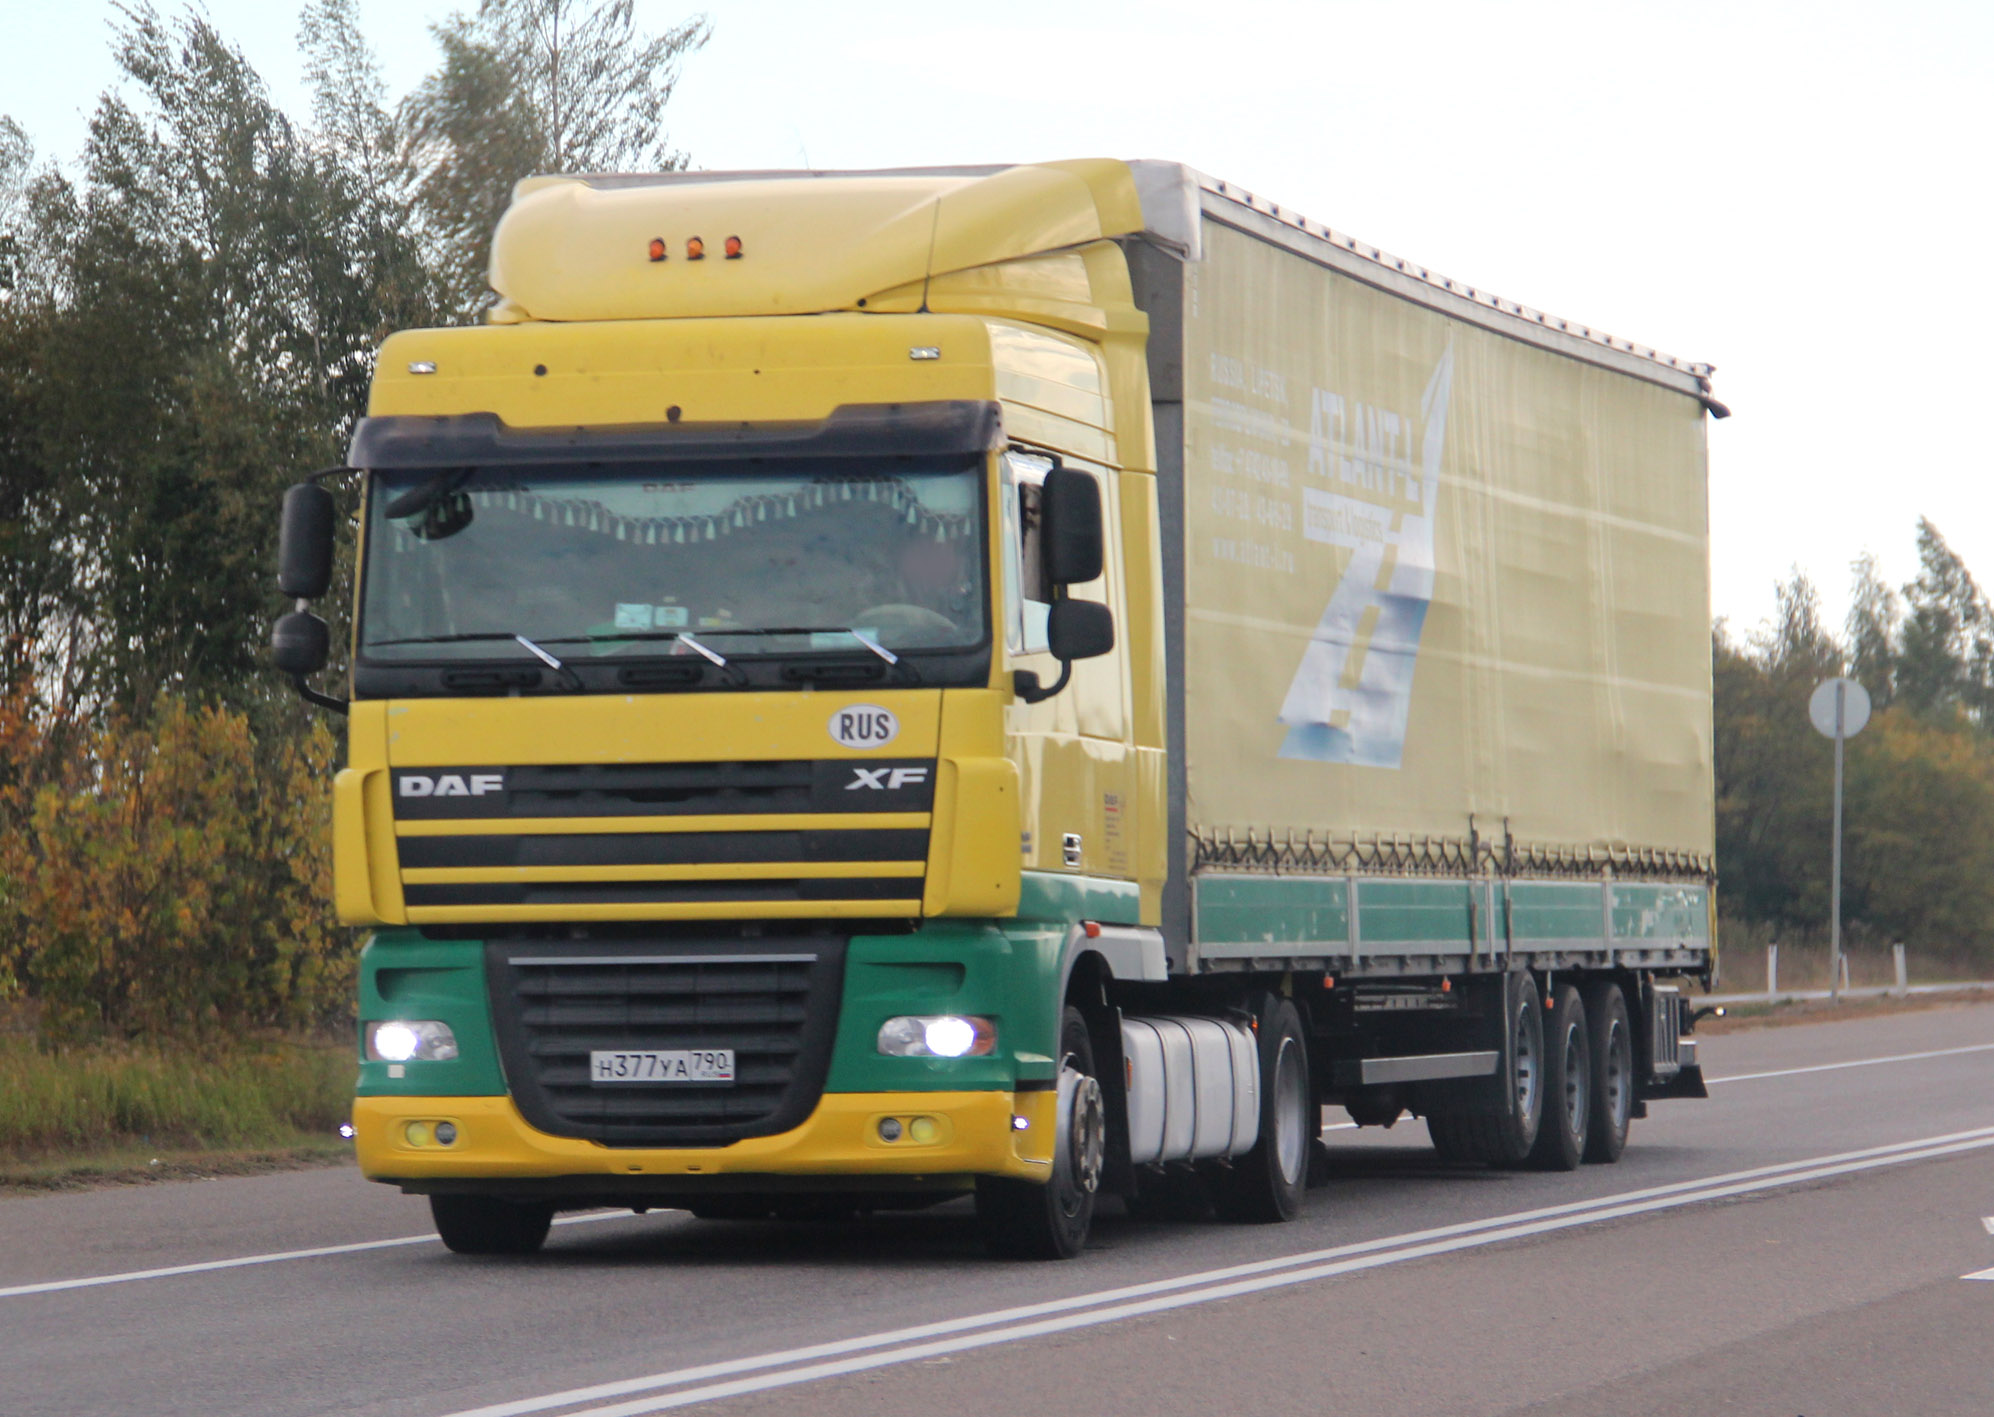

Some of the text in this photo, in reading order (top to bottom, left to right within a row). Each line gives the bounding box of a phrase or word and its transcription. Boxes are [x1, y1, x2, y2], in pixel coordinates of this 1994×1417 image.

[840, 712, 891, 741] RUS
[399, 775, 504, 797] DAF
[844, 767, 928, 790] XF
[693, 1052, 728, 1070] 790
